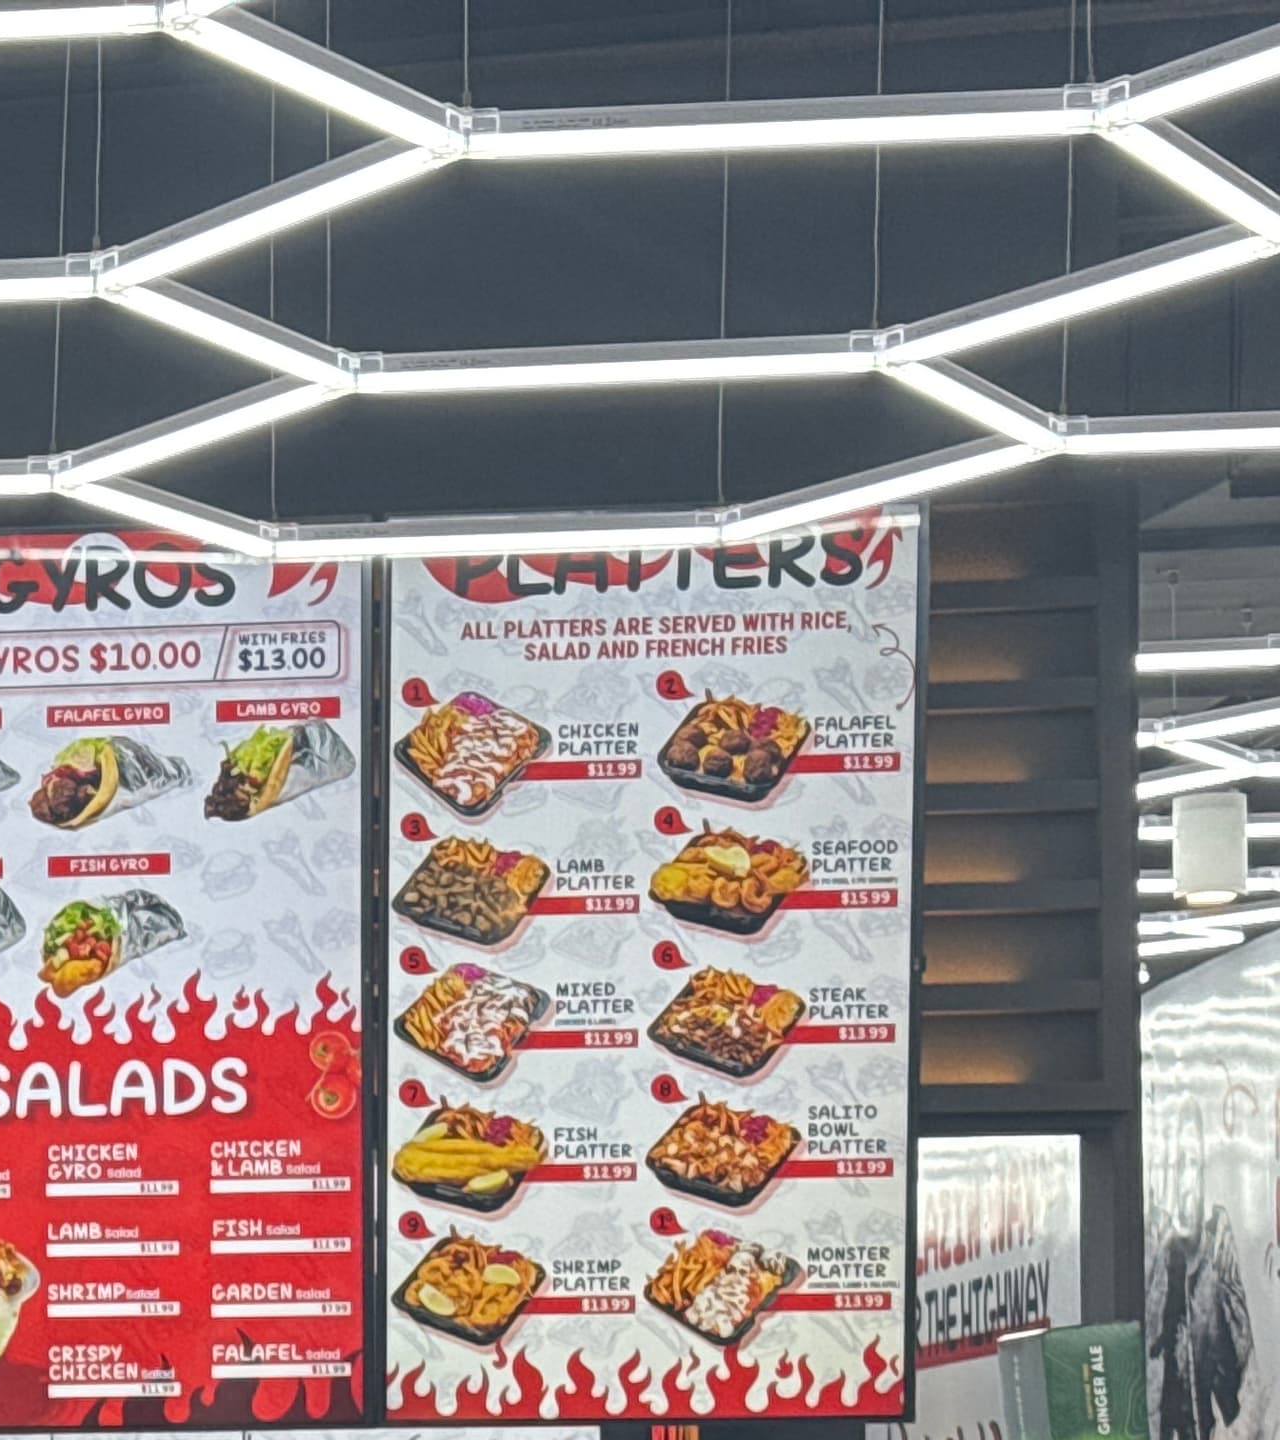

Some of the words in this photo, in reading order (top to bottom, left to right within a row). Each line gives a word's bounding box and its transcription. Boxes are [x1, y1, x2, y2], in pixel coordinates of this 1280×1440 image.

[461, 622, 499, 641] ALL
[503, 619, 607, 639] PLATTERS
[613, 617, 654, 636] ARE
[658, 615, 737, 635] SERVED
[742, 613, 794, 633] WITH
[799, 611, 853, 634] RICE,
[239, 631, 280, 645] WITH
[282, 630, 326, 645] FRIES
[89, 640, 202, 673] $10.00
[524, 641, 592, 662] SALAD
[597, 640, 640, 660] AND
[645, 638, 725, 658] FRENCH
[731, 636, 788, 656] FRIES
[239, 646, 326, 671] $13.00
[54, 707, 121, 723] FALAFEL
[124, 705, 164, 722] GYRO
[236, 702, 277, 718] LAMB
[280, 700, 321, 716] GYRO
[558, 723, 640, 740] CHICKEN
[558, 740, 638, 757] PLATTER
[587, 762, 637, 777] $12.99
[811, 839, 899, 856] SEAFOOD
[69, 857, 107, 873] FISH
[109, 856, 150, 872] GYRO
[811, 856, 892, 872] PLATTER
[840, 891, 890, 906] $15.99
[47, 1222, 102, 1240] LAMB
[212, 1219, 263, 1237] FISH
[807, 1246, 891, 1262] MONSTER
[807, 1262, 886, 1278] PLATTER
[47, 1282, 127, 1301] SHRIMP
[212, 1282, 294, 1301] GARDEN
[960, 1258, 1050, 1346] HIGHWAY
[212, 1343, 303, 1362] FALAFEL
[1090, 1344, 1104, 1373] ALE
[1092, 1379, 1111, 1436] GINGER
